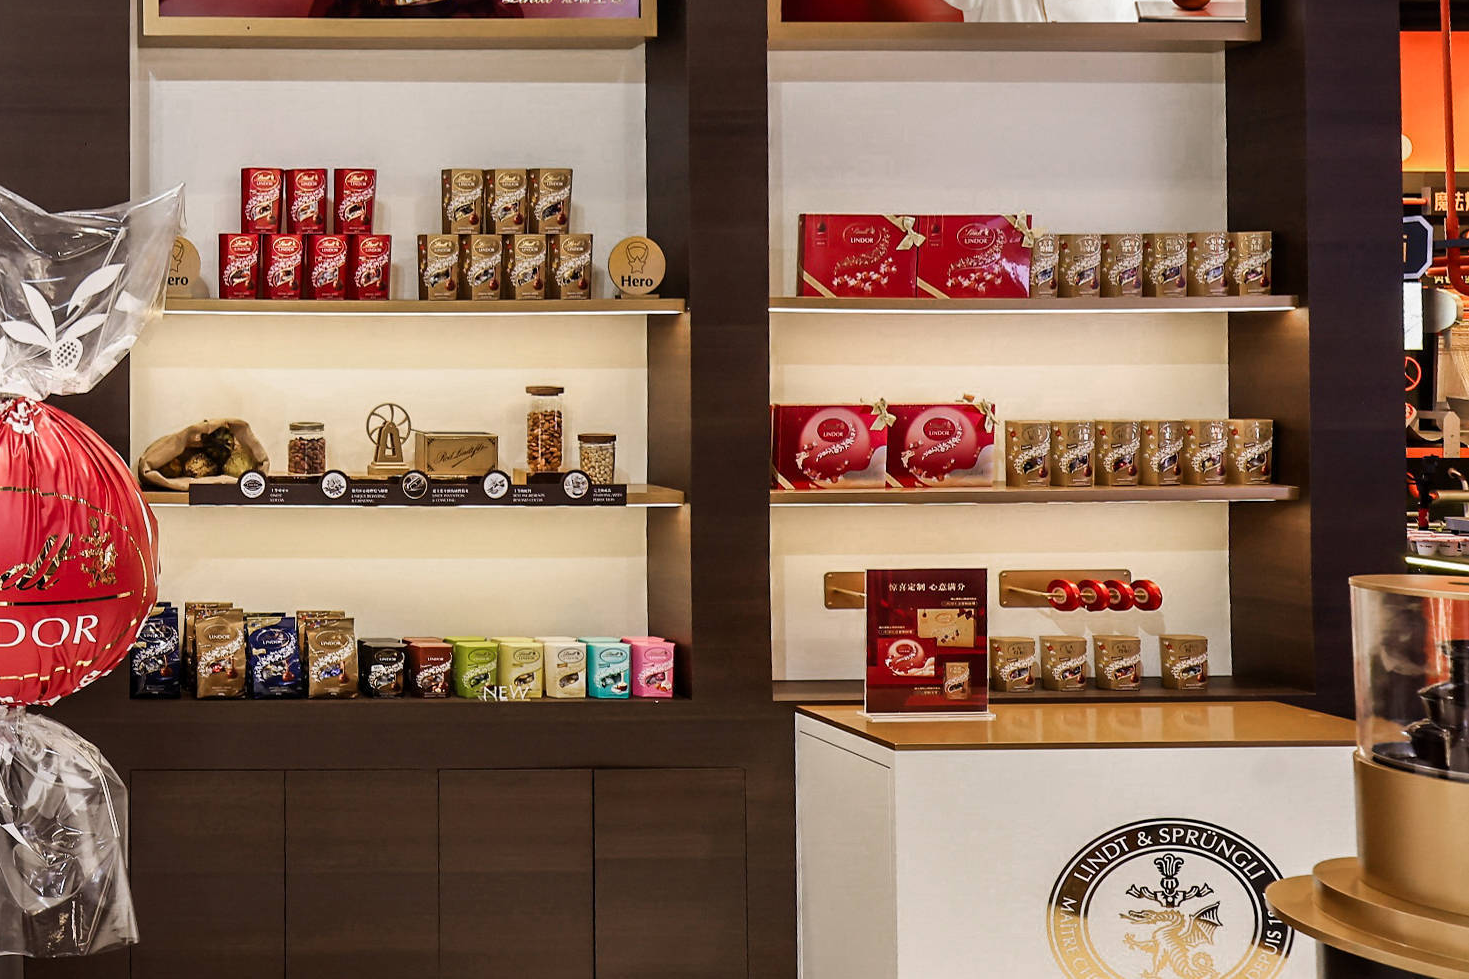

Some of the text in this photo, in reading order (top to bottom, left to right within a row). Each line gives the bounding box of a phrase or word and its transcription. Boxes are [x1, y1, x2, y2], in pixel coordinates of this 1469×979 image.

[1434, 191, 1469, 212] 魔法
[167, 276, 189, 286] ero
[621, 275, 654, 287] Hero
[483, 685, 530, 702] NEW
[1073, 827, 1266, 883] LINDT & SPRÜNGLI
